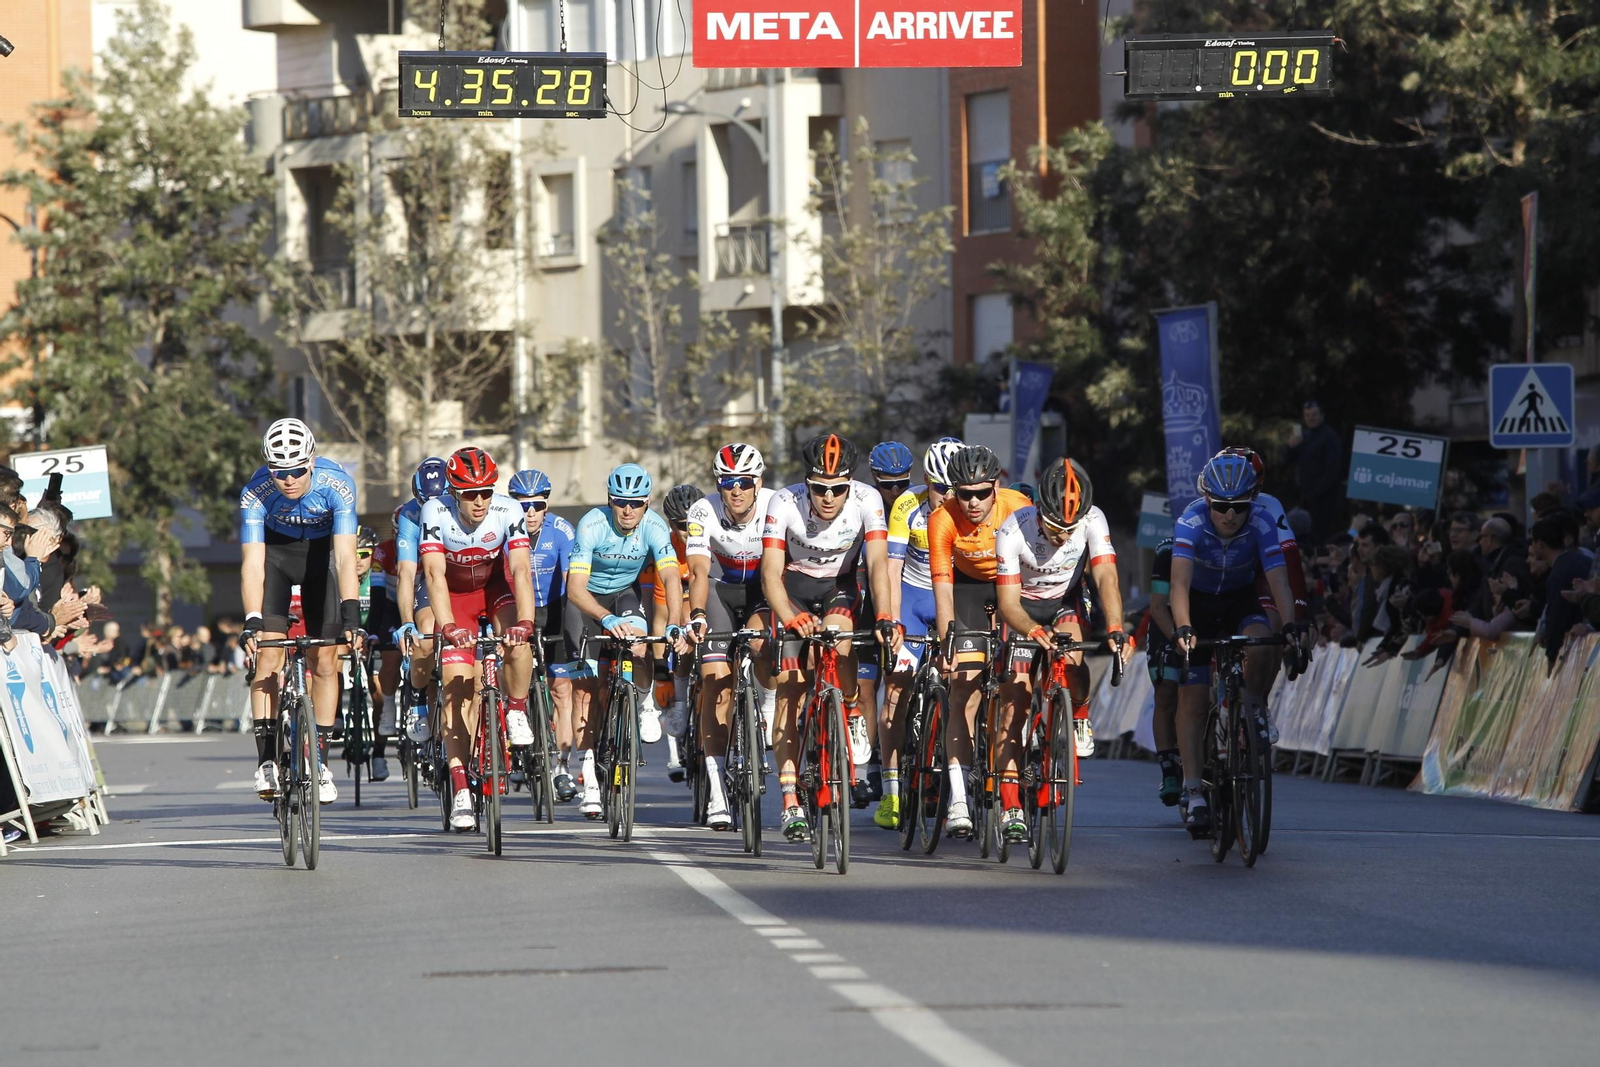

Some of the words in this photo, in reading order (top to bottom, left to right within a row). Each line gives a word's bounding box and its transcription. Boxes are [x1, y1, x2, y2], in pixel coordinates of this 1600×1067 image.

[706, 11, 844, 40] META
[866, 10, 1014, 39] ARRIVEE
[1376, 435, 1422, 459] 25
[41, 454, 84, 477] 25
[1375, 472, 1432, 490] cajamar
